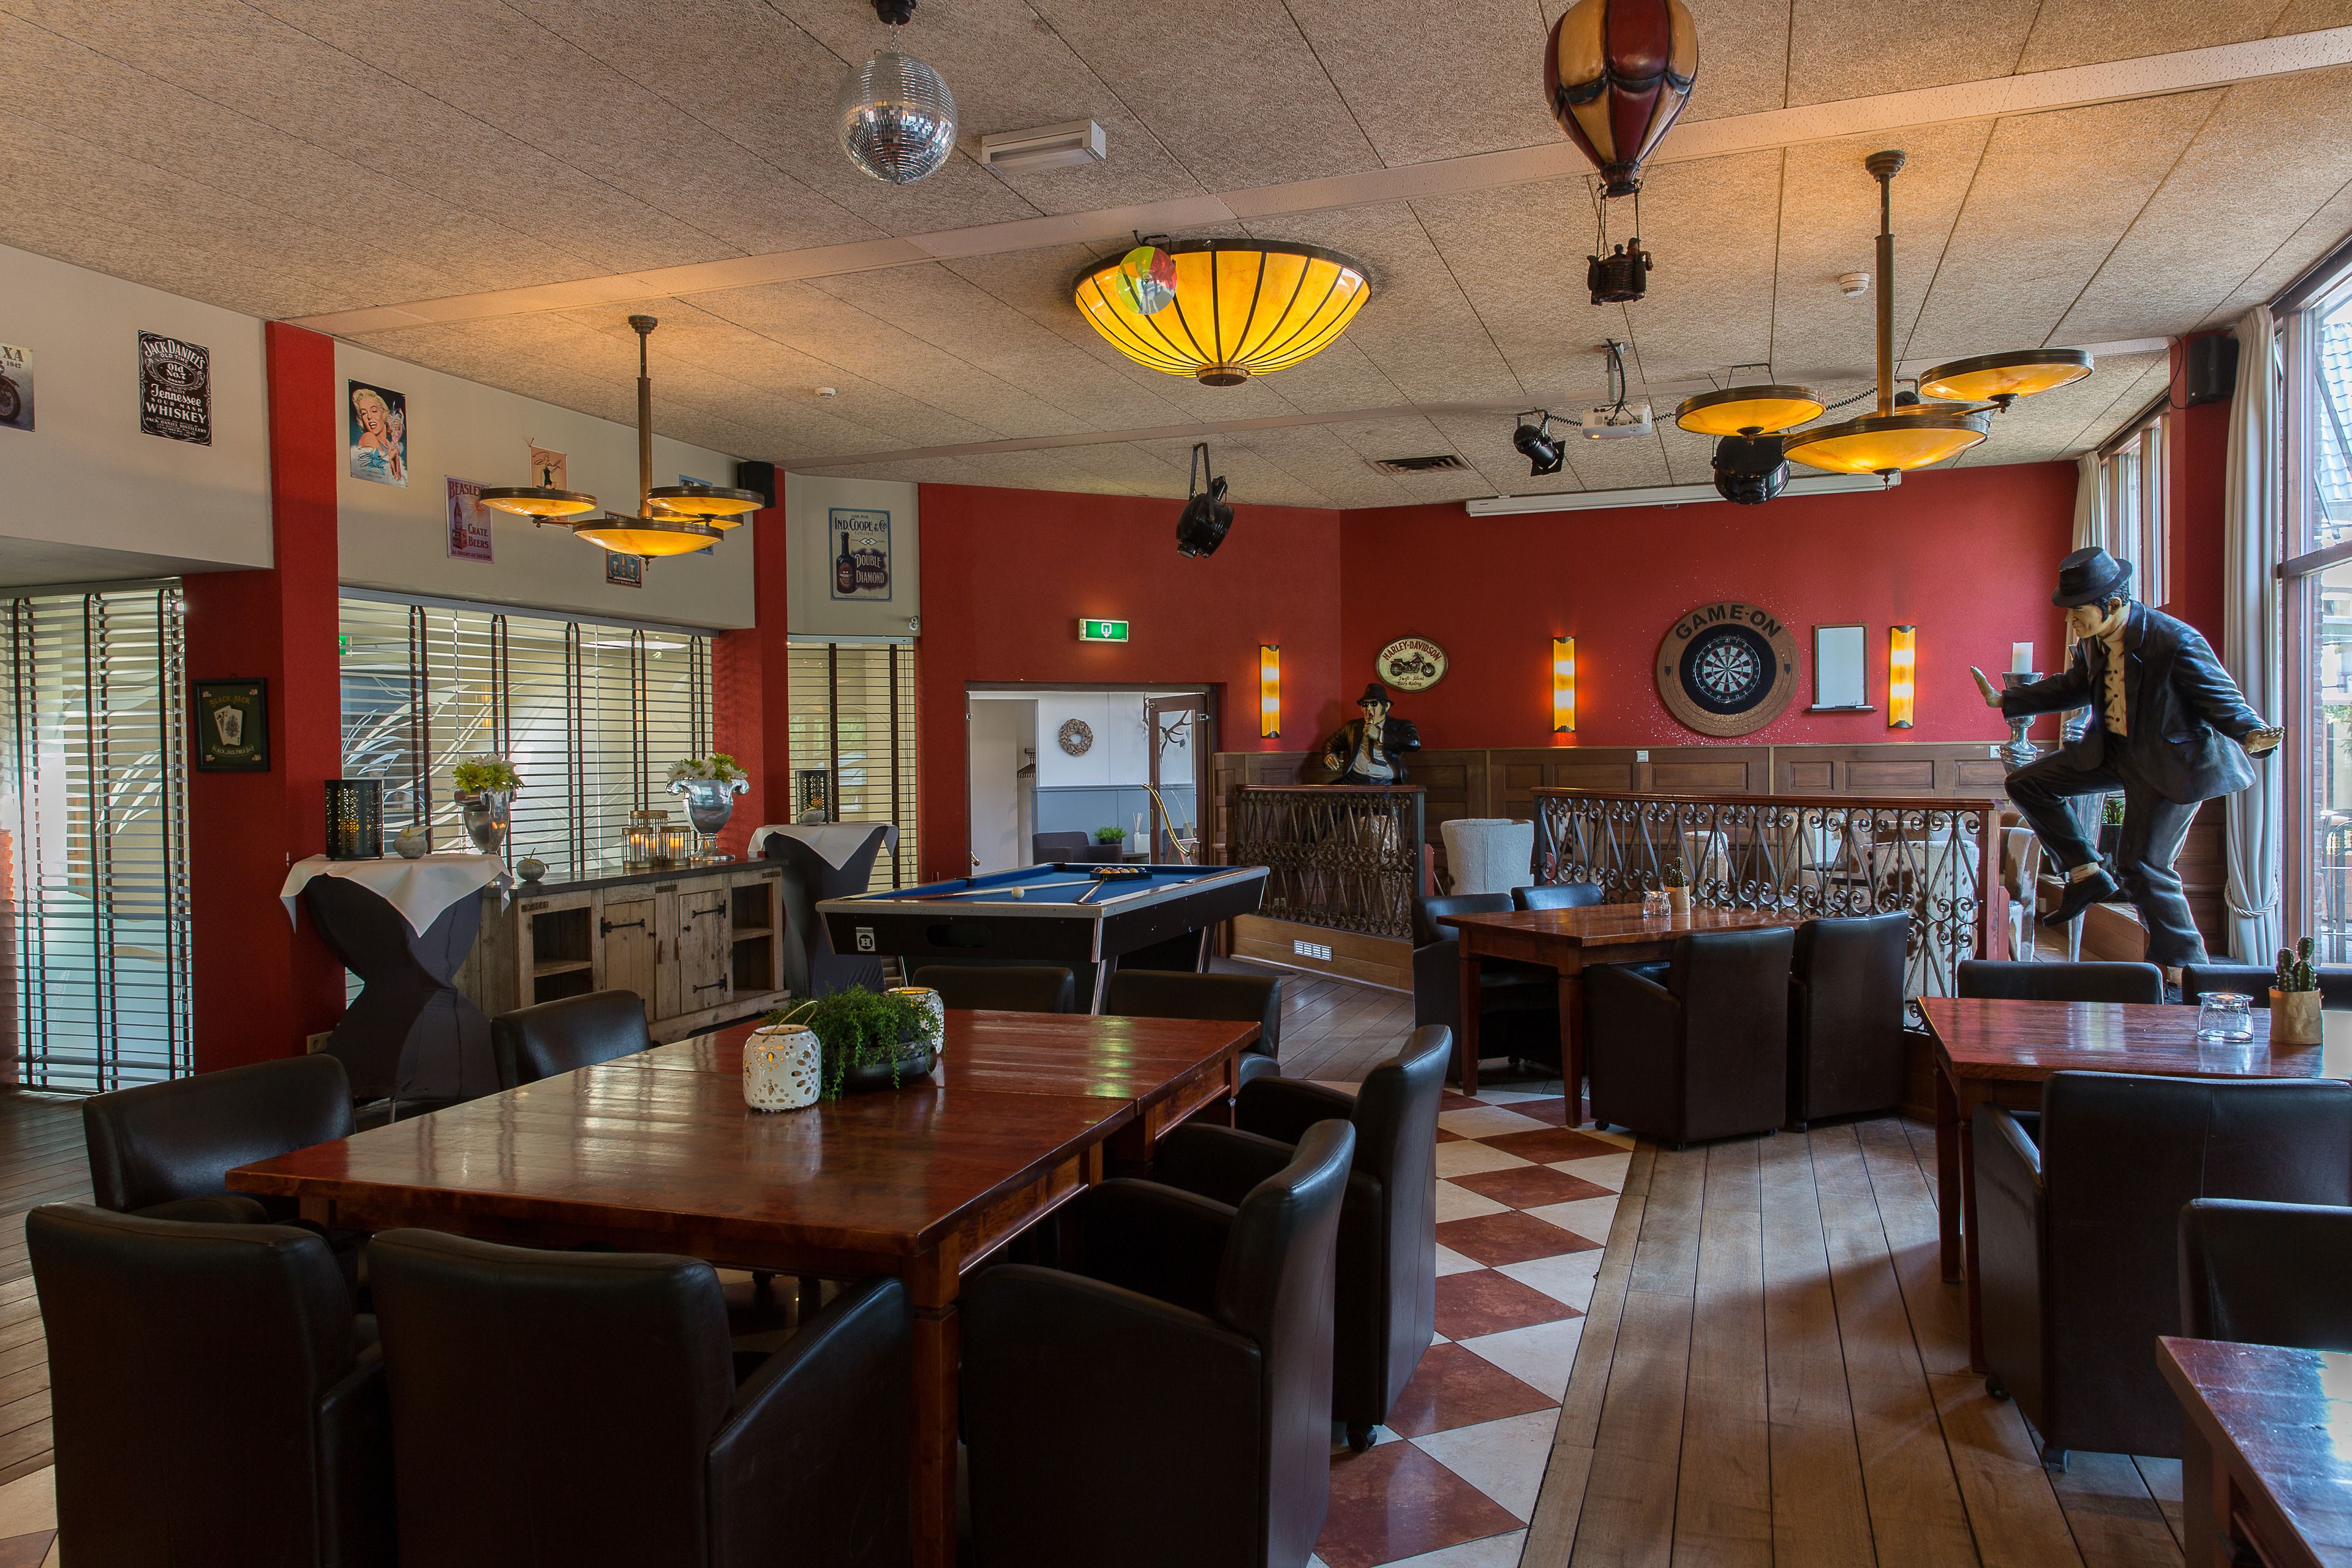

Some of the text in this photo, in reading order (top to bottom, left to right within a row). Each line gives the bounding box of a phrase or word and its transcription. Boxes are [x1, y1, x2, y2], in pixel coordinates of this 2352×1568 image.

[143, 339, 205, 369] JACK DANIEL'S
[174, 354, 189, 364] TIME
[167, 363, 184, 373] Old
[151, 383, 202, 407] Tennessee
[151, 398, 203, 413] SOUR MASH
[146, 402, 206, 424] WHISKEY
[468, 523, 488, 537] CRATE
[469, 536, 489, 549] BEERS
[855, 554, 882, 568] DOUBLE
[856, 570, 884, 584] DIAMOND
[1382, 641, 1442, 661] HARLEY-DAVIDSON
[209, 695, 251, 707] BLACK JACK
[860, 938, 872, 946] H
